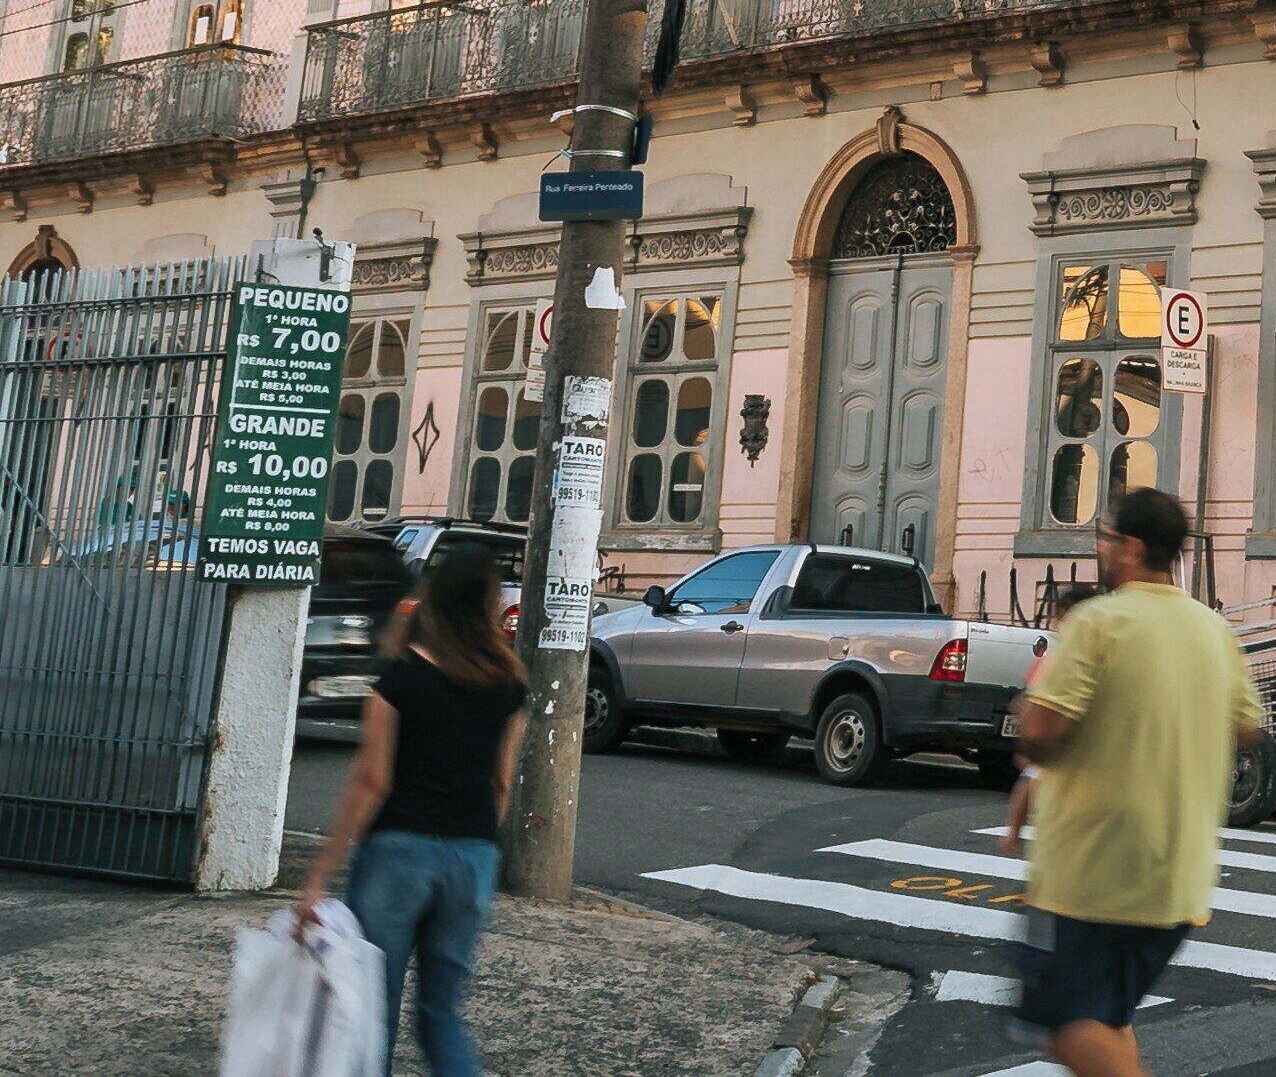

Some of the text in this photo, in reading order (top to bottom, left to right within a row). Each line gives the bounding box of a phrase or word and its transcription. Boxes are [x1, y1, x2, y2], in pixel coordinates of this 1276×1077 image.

[545, 183, 634, 193] Rua Ferreira Penteado
[239, 287, 349, 313] PEQUENO
[281, 315, 317, 327] HORA
[1179, 306, 1189, 334] E
[237, 327, 341, 355] R$ 7,00
[239, 356, 331, 371] DEMAIS HORAS
[1167, 360, 1200, 369] DESCARGA
[262, 370, 307, 381] R$ 3,00
[236, 379, 330, 394] ATÉ MEIA HORA
[259, 393, 304, 404] R$ 5,00
[230, 414, 326, 438] GRANDE
[239, 440, 277, 451] HORA
[216, 453, 328, 482] R$ 10,00
[225, 484, 317, 497] DEMAIS HORAS
[247, 497, 292, 508] R$ 4,00
[220, 508, 316, 521] ATÉ MEIA HORA
[245, 521, 290, 532] R$ 8,00
[208, 538, 320, 556] TEMOS VAGA
[204, 562, 315, 581] PARA DIÁRIA
